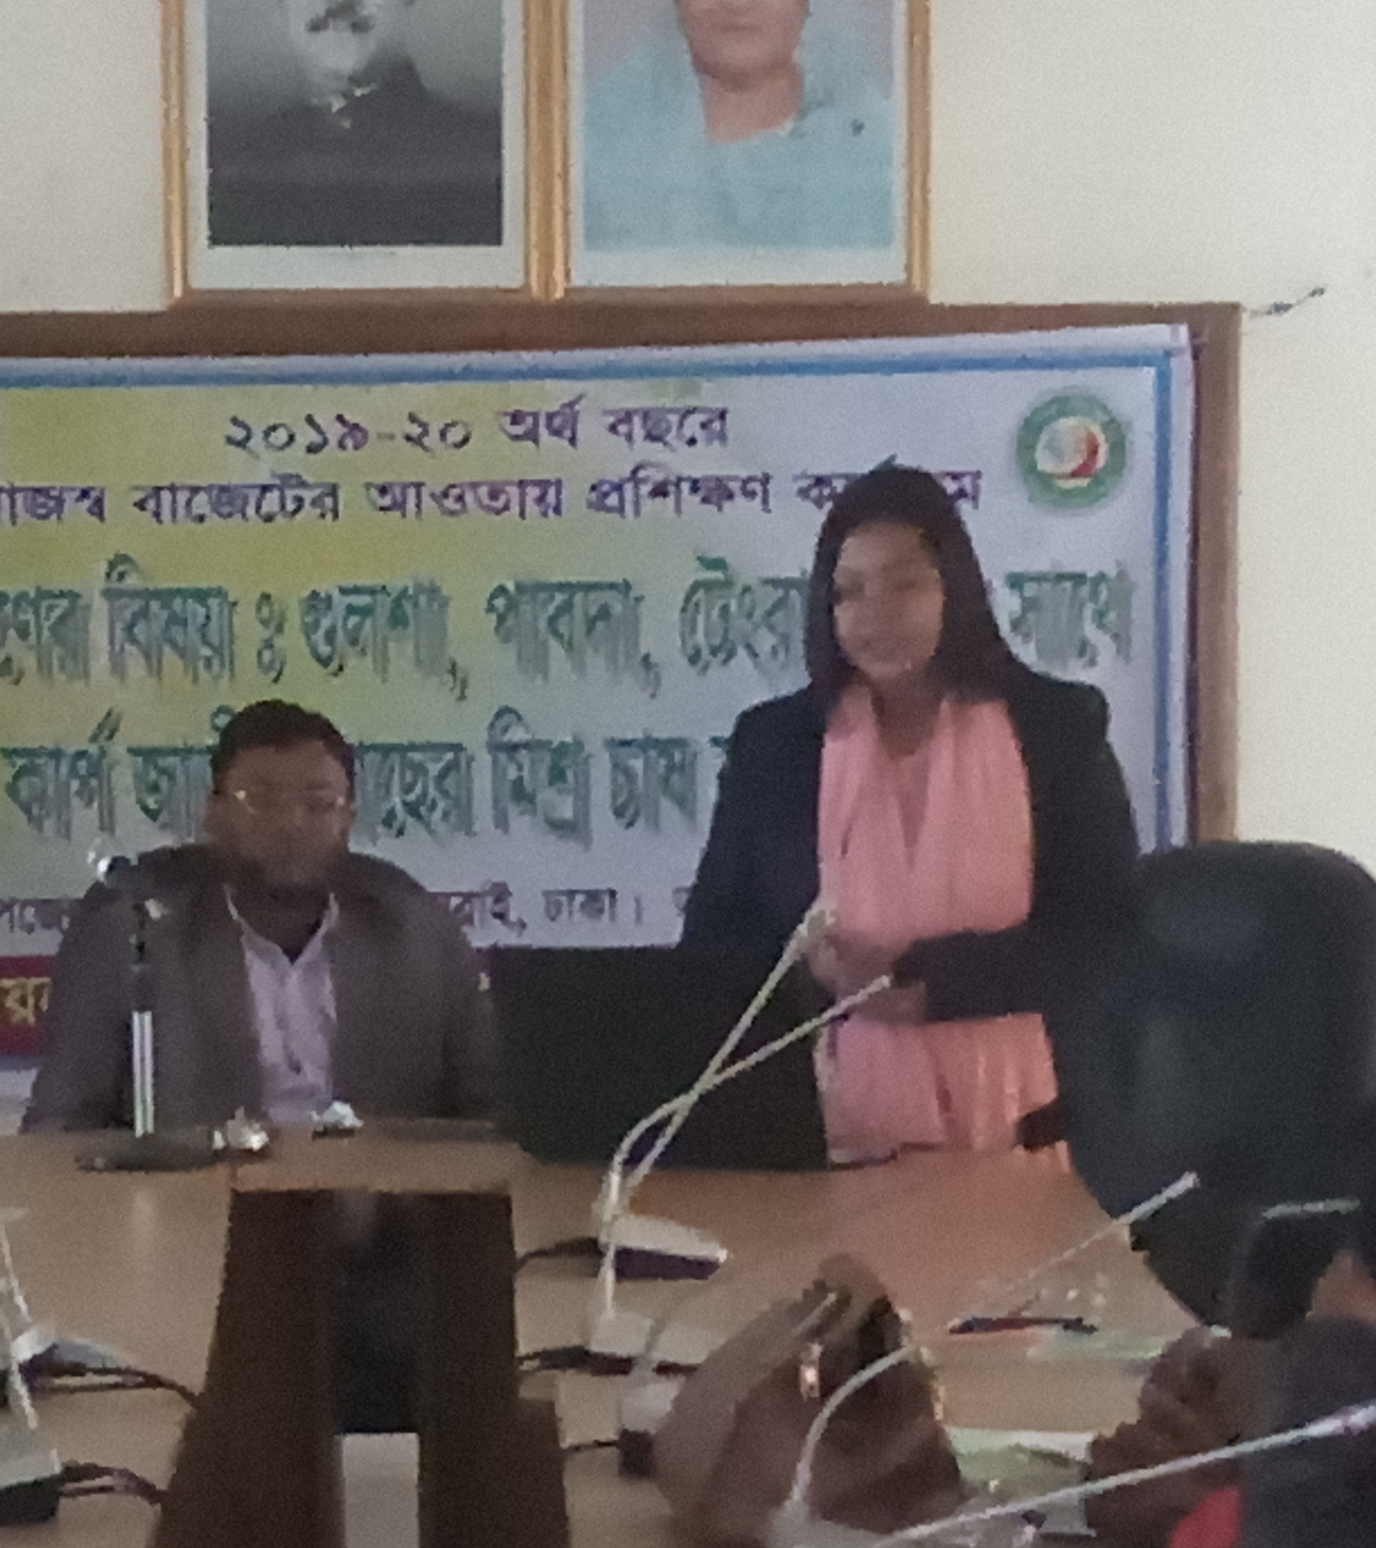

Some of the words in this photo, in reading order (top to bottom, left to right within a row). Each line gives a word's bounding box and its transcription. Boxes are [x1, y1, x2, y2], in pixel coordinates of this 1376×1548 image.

[225, 411, 472, 457] ২০১৯-২০
[498, 393, 584, 449] অর্থ
[603, 406, 729, 452] বছরে
[129, 470, 341, 526] বাজেটের
[364, 479, 563, 521] আওতায়
[585, 460, 772, 520] প্রশিক্ষণ
[101, 554, 236, 686] বিষয়
